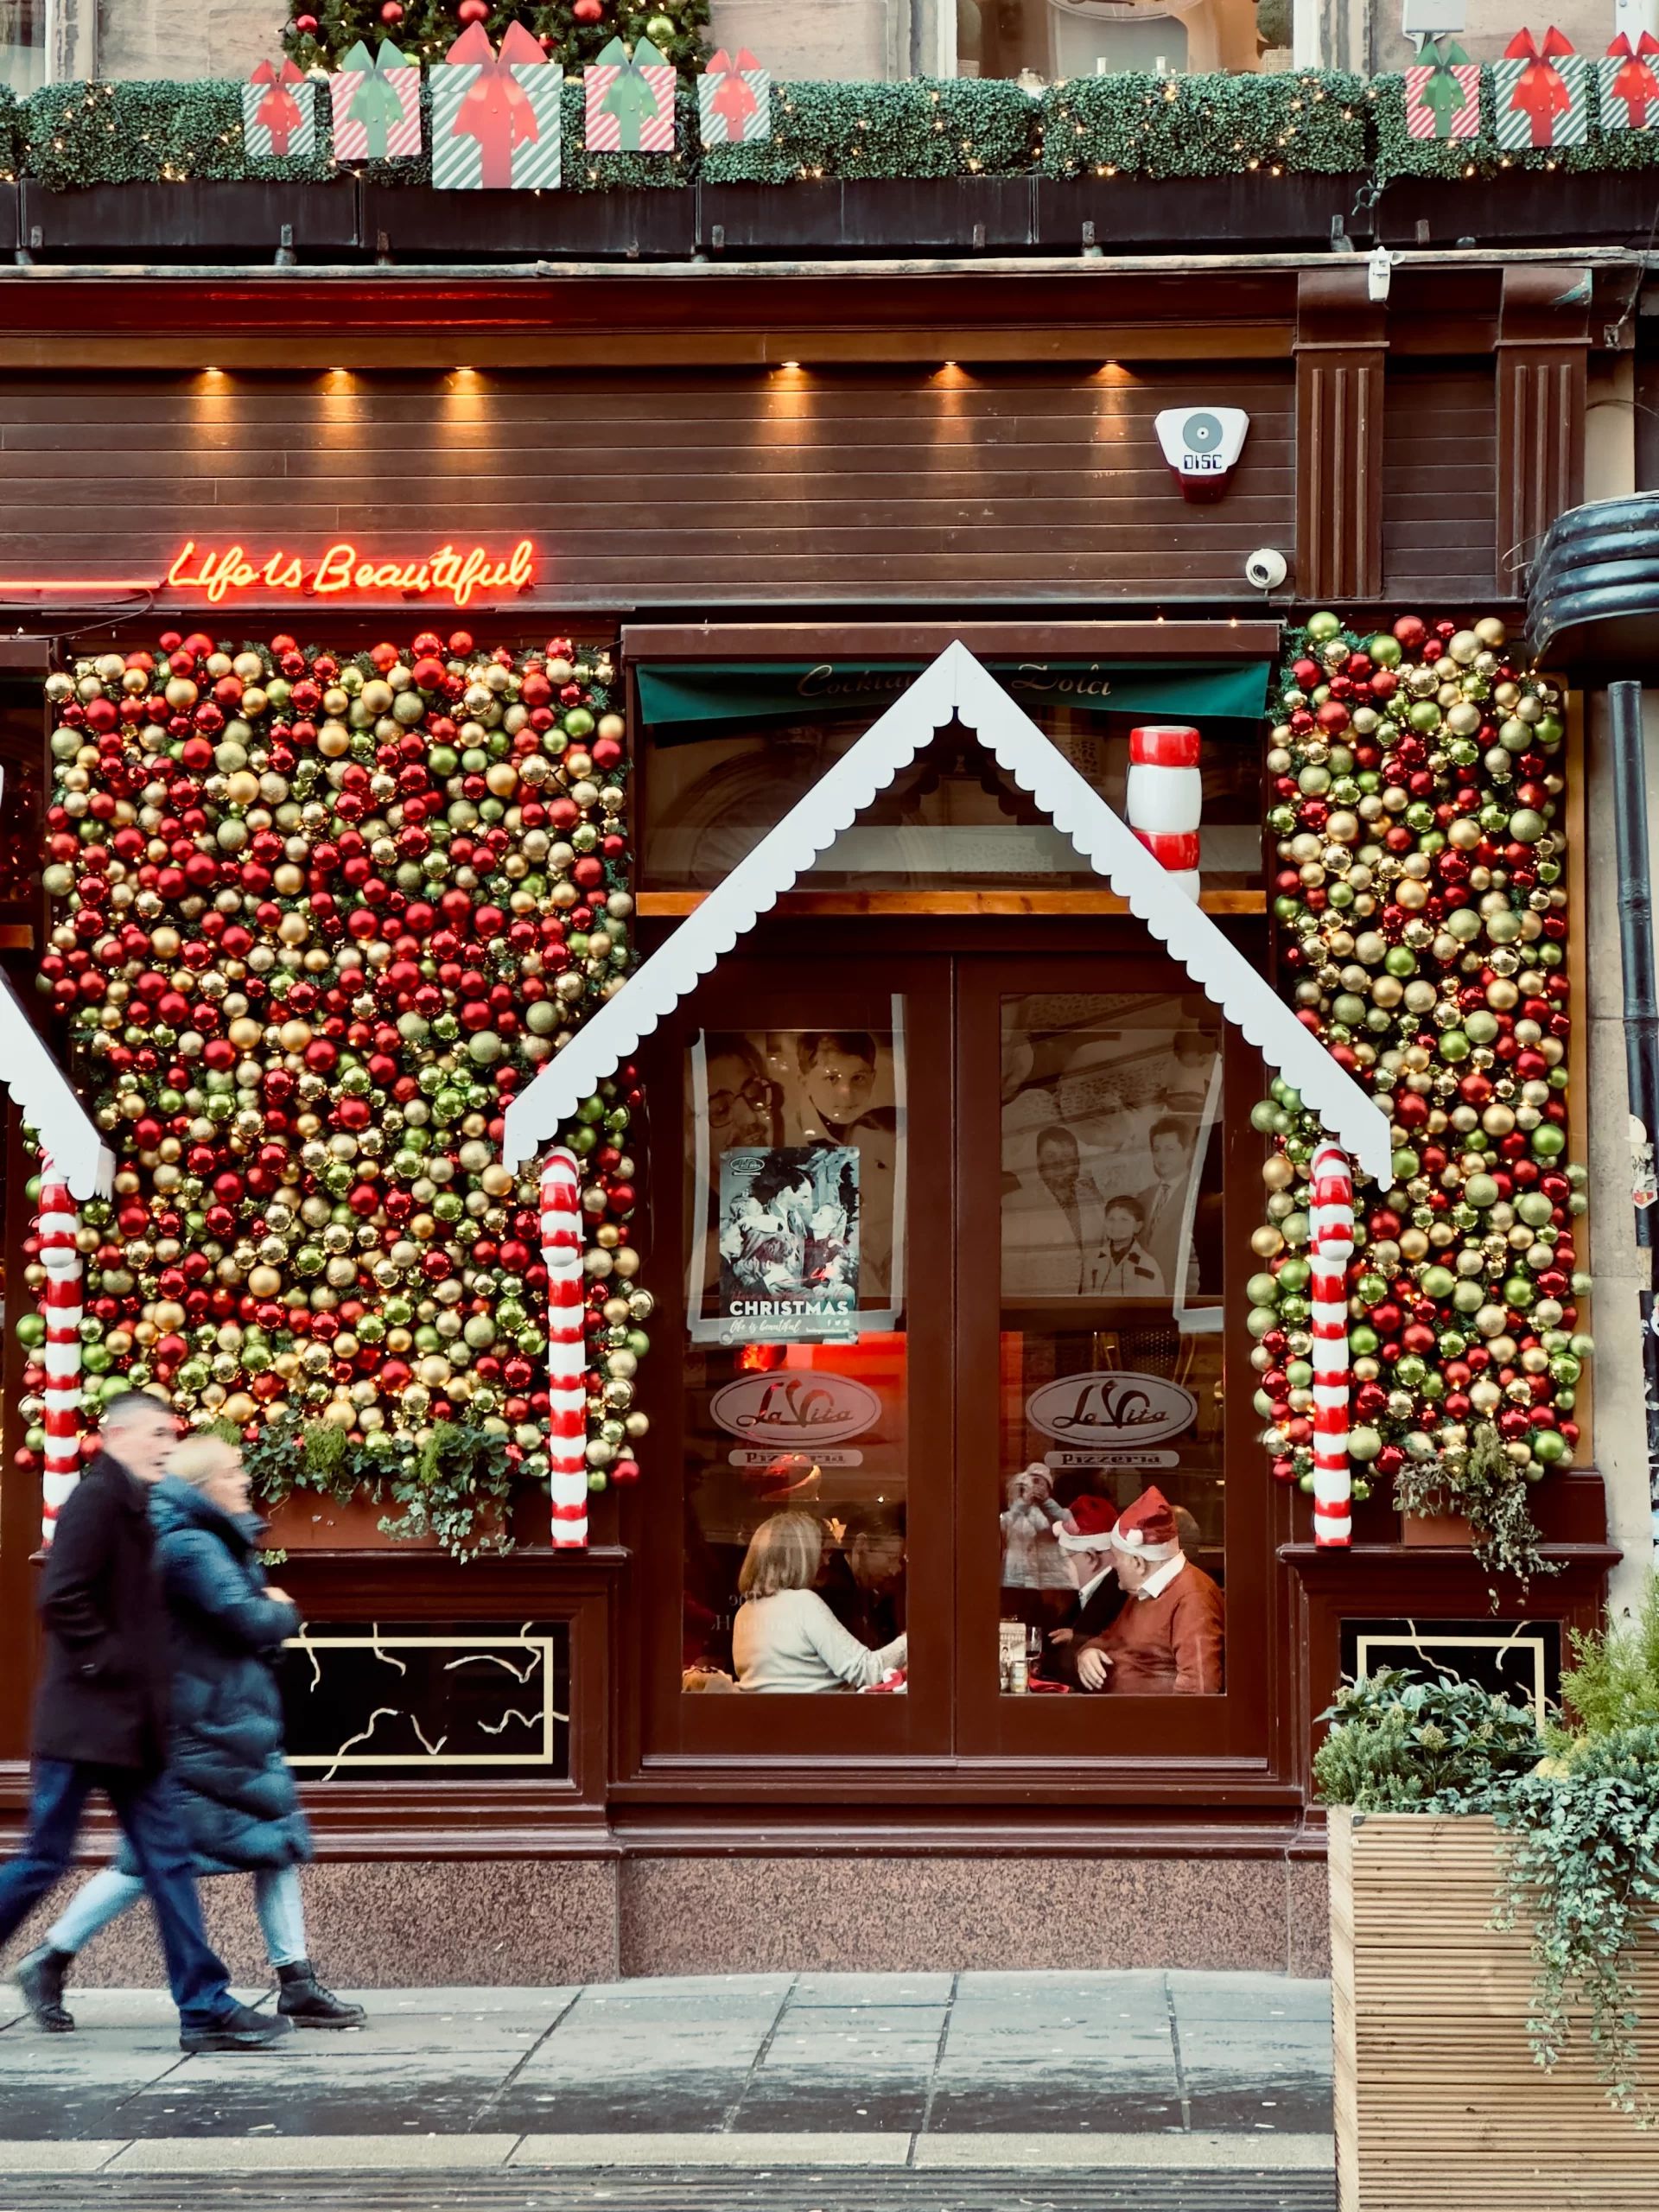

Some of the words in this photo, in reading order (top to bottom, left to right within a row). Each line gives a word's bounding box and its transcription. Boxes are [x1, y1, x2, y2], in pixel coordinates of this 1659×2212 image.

[1184, 454, 1223, 470] DISC
[167, 540, 257, 602] Life
[260, 552, 305, 588] is
[312, 539, 535, 606] Beautiful
[797, 664, 913, 696] Cocktai
[729, 1300, 849, 1316] CHRISTMAS
[736, 1382, 785, 1427] La
[785, 1378, 855, 1428] Vita
[1101, 1379, 1170, 1430] Vita
[745, 1452, 846, 1465] Pizria
[1060, 1453, 1162, 1465] Pizzeria
